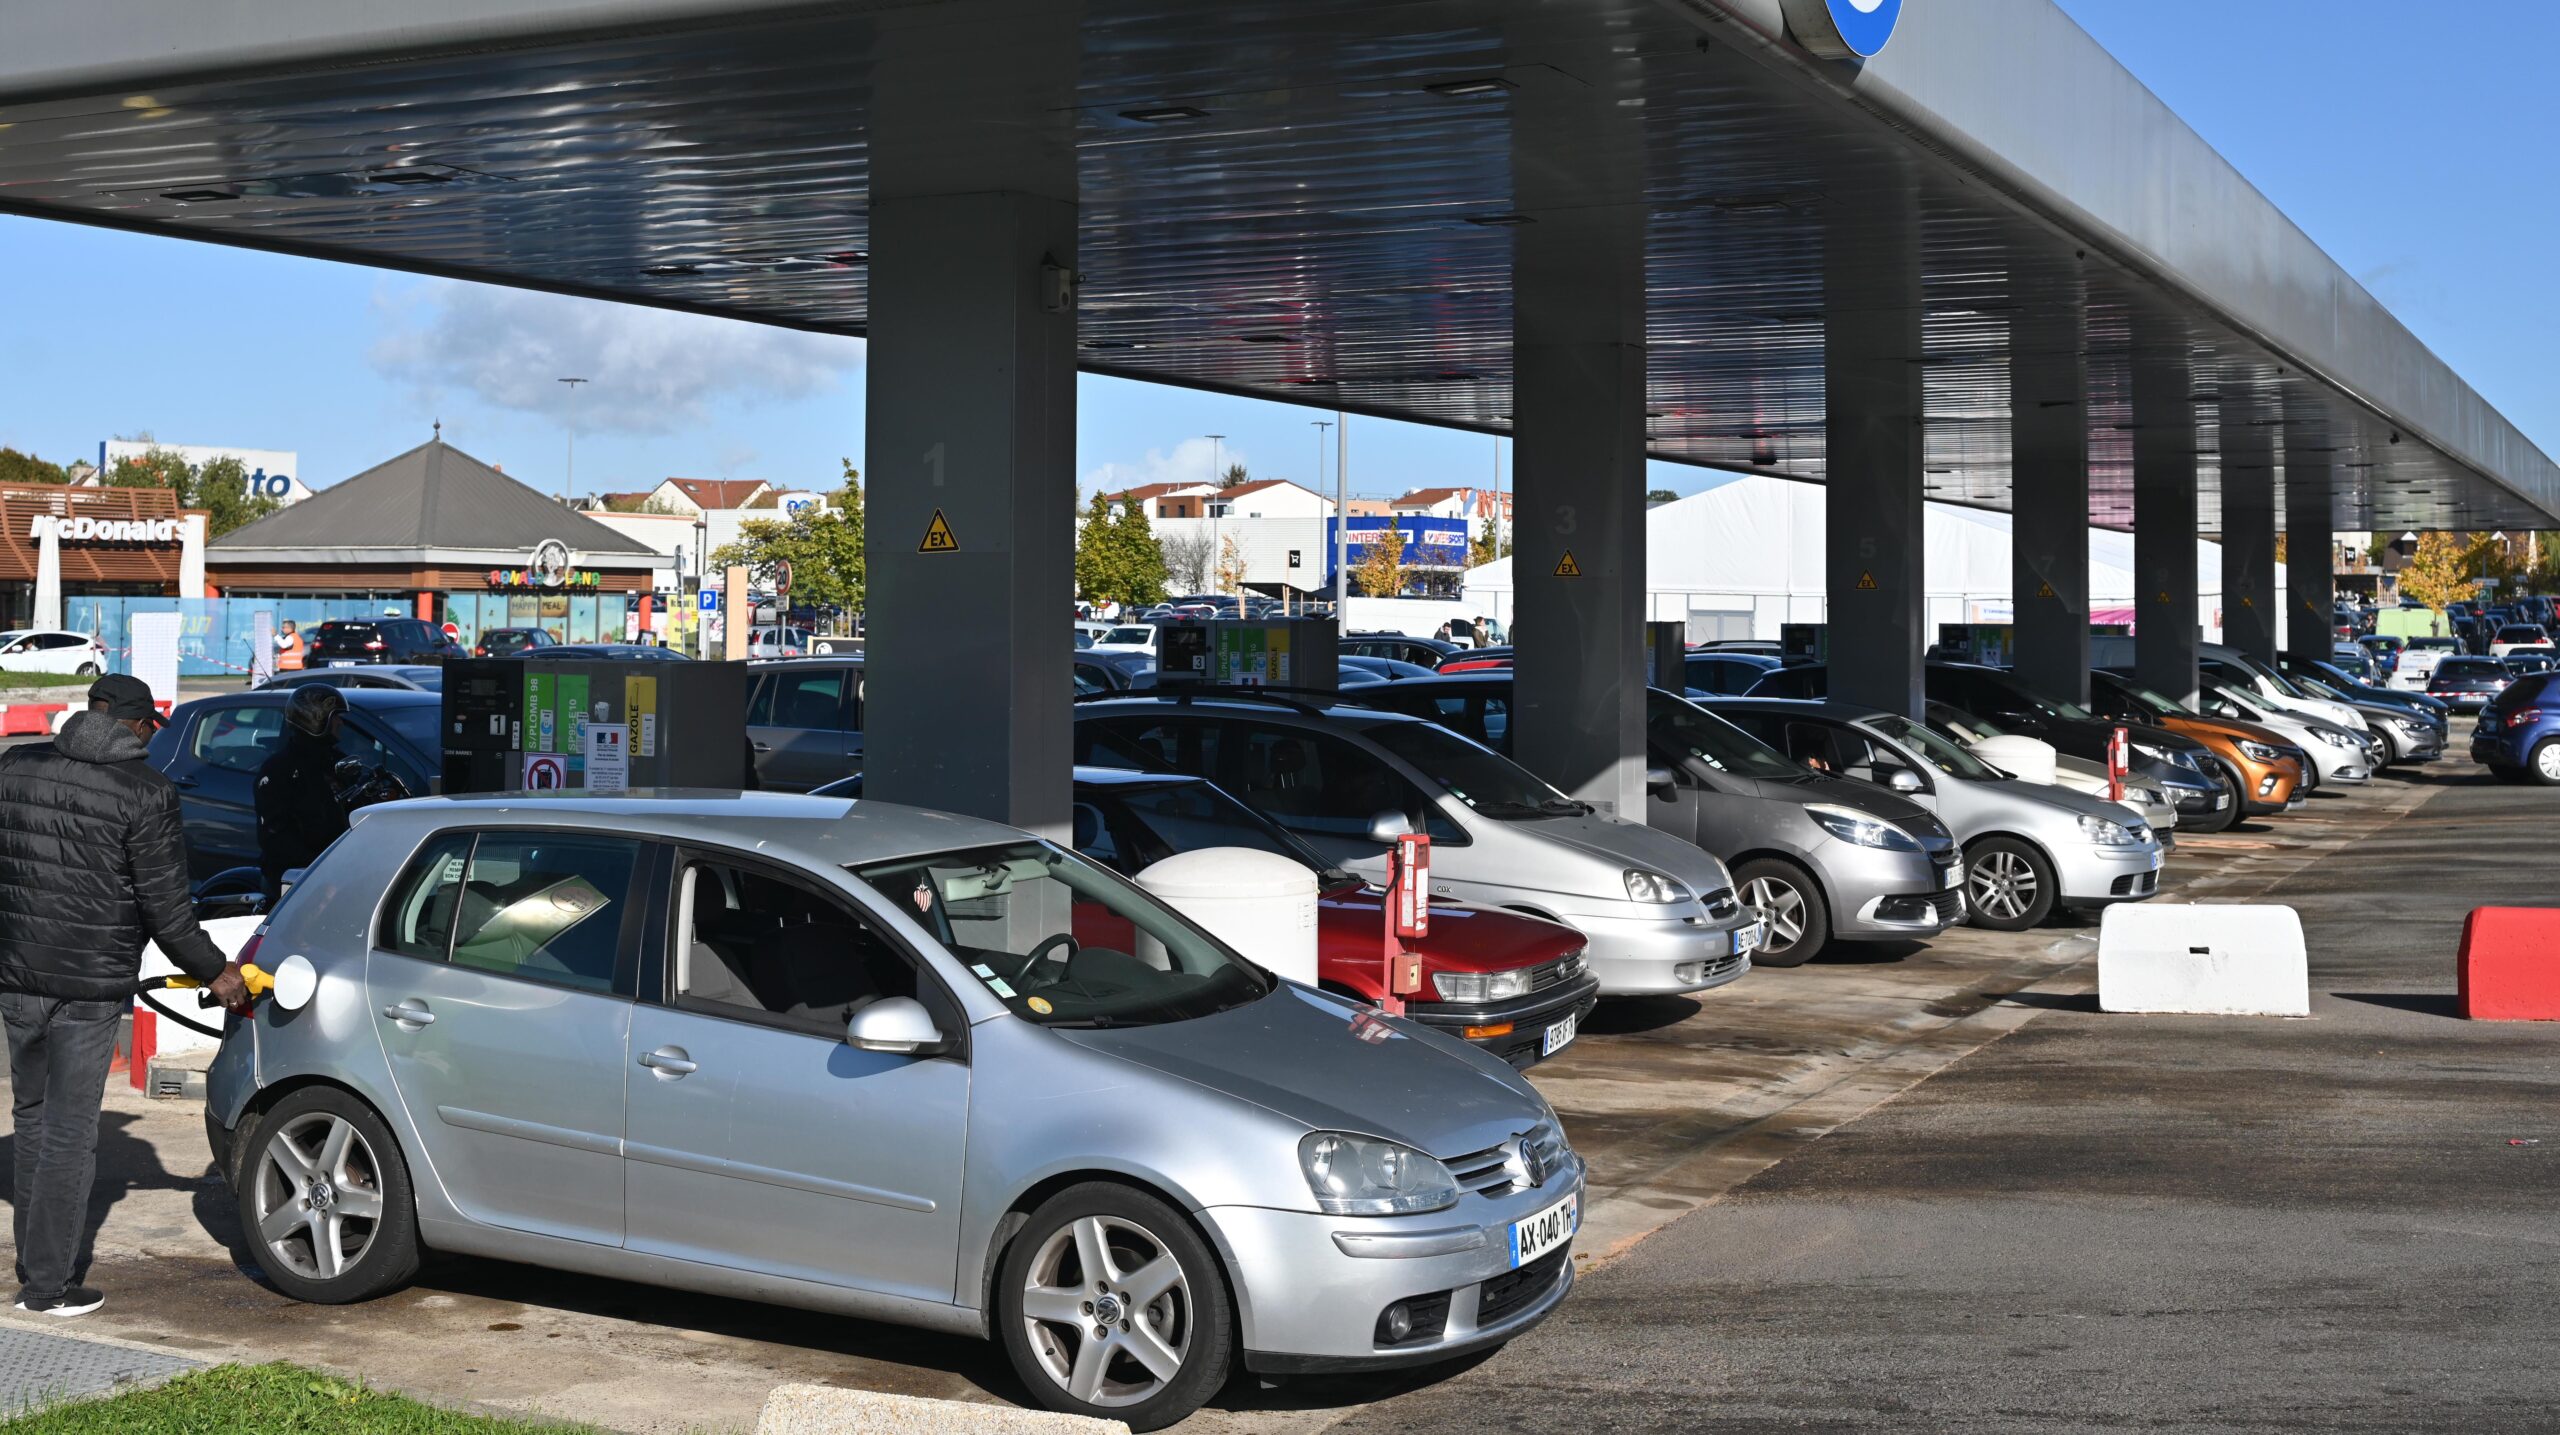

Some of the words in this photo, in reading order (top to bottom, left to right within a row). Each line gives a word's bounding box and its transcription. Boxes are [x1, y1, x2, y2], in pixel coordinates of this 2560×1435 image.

[923, 442, 944, 486] 1
[1554, 504, 1577, 534] 3
[930, 532, 947, 547] EX
[1561, 564, 1573, 573] EX
[490, 570, 544, 585] RONALD
[565, 571, 600, 585] LAND
[777, 571, 787, 585] 20
[542, 602, 561, 610] MEAL
[703, 594, 712, 607] P
[1196, 657, 1202, 668] 3
[530, 678, 539, 691] 98
[493, 715, 502, 734] 1
[529, 695, 538, 749] S/PLOMB
[630, 704, 639, 753] GAZOLE
